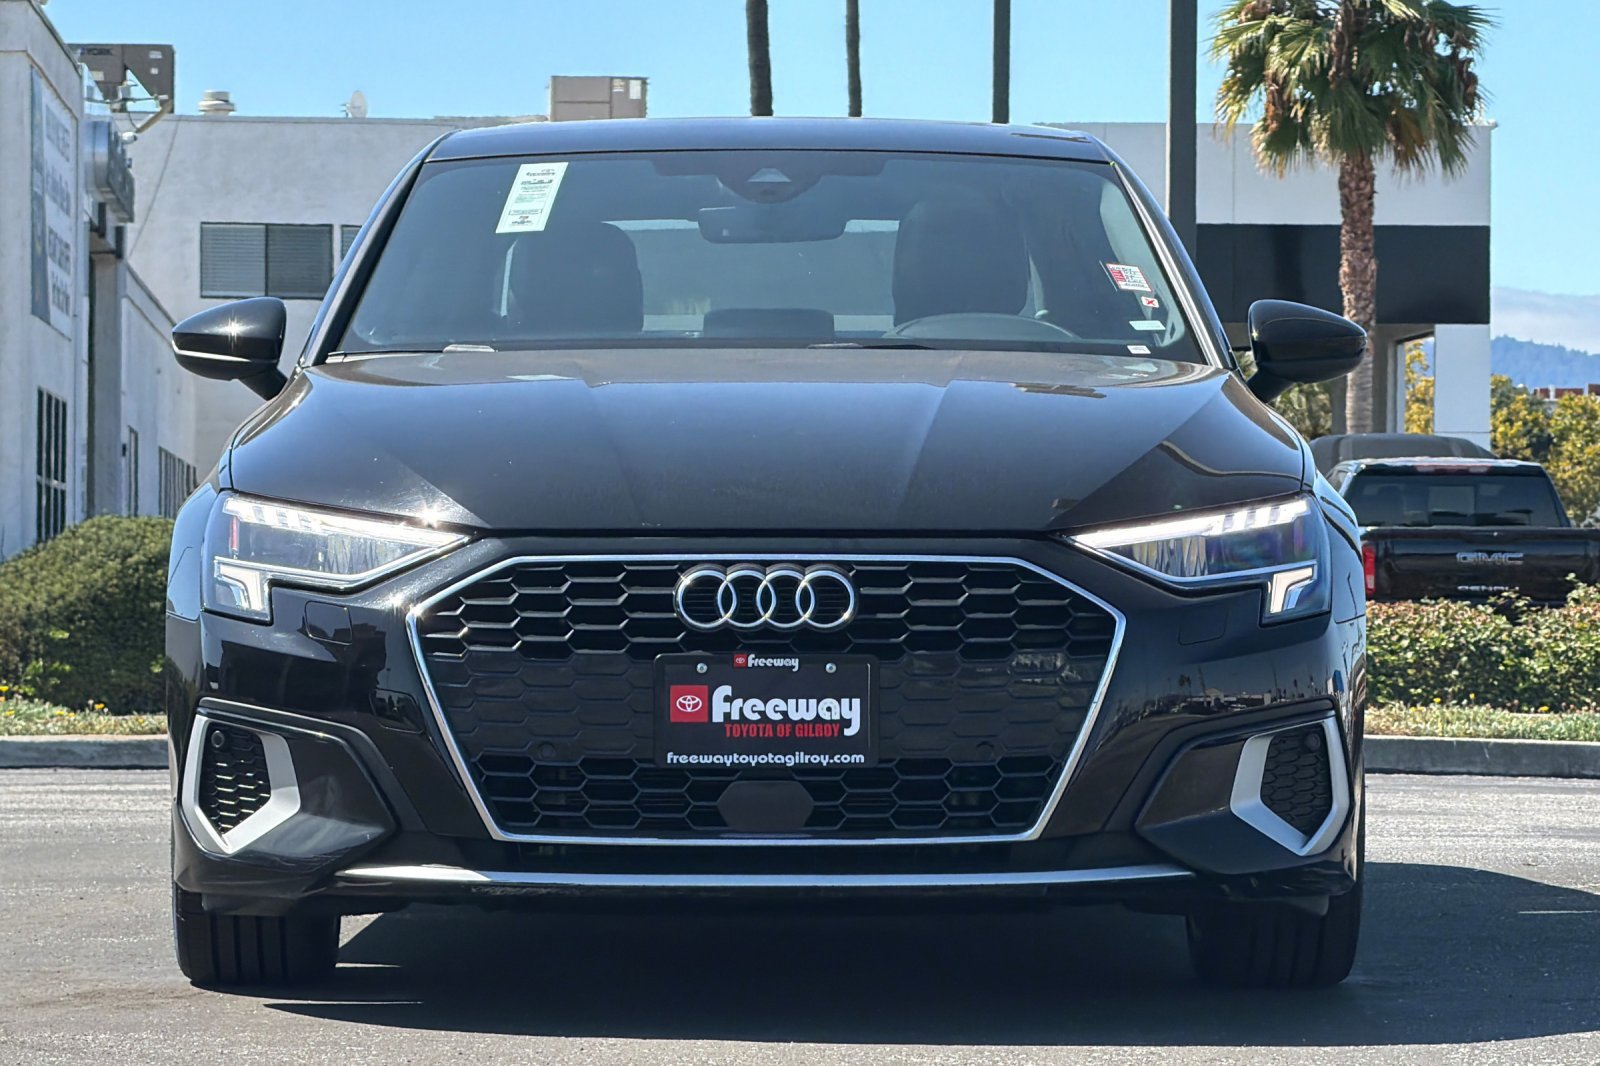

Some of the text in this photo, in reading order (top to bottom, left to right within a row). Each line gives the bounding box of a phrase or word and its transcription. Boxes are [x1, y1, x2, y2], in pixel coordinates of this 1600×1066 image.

[1456, 552, 1524, 565] GMC
[747, 654, 799, 671] freeway
[712, 685, 861, 736] freeway
[725, 724, 840, 737] TOYOTA OF GILROY
[667, 752, 864, 766] freewaytoyotagilroy.com
